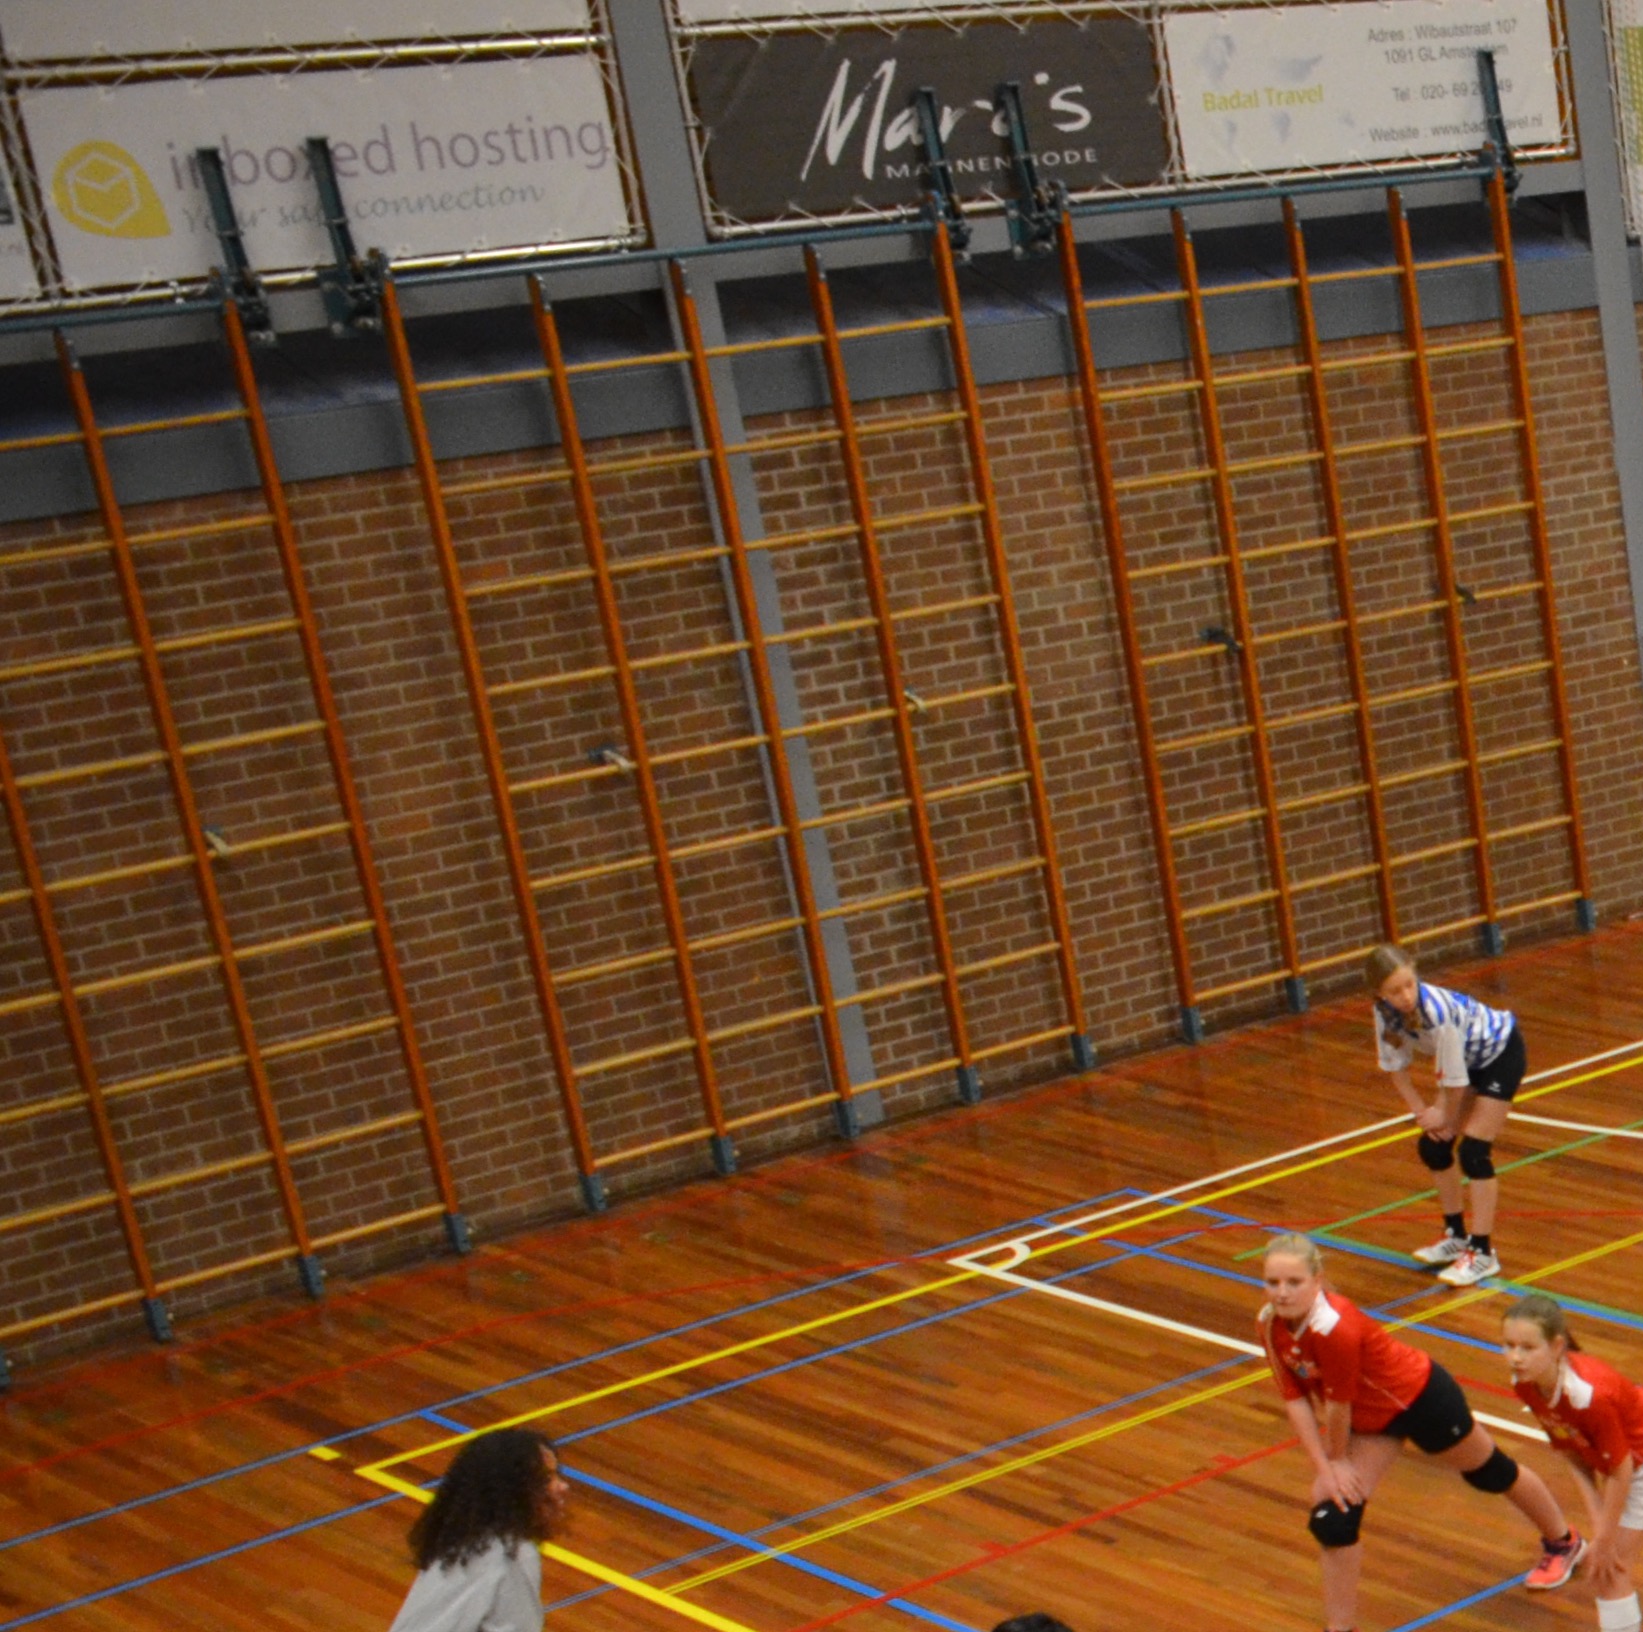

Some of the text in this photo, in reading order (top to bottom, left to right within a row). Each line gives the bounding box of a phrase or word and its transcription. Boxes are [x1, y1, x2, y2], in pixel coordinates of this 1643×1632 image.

[1368, 27, 1405, 43] Adres
[1203, 83, 1324, 113] Badal Travel
[410, 115, 610, 171] hosting
[885, 148, 1098, 179] MANENODE
[355, 183, 541, 219] connection
